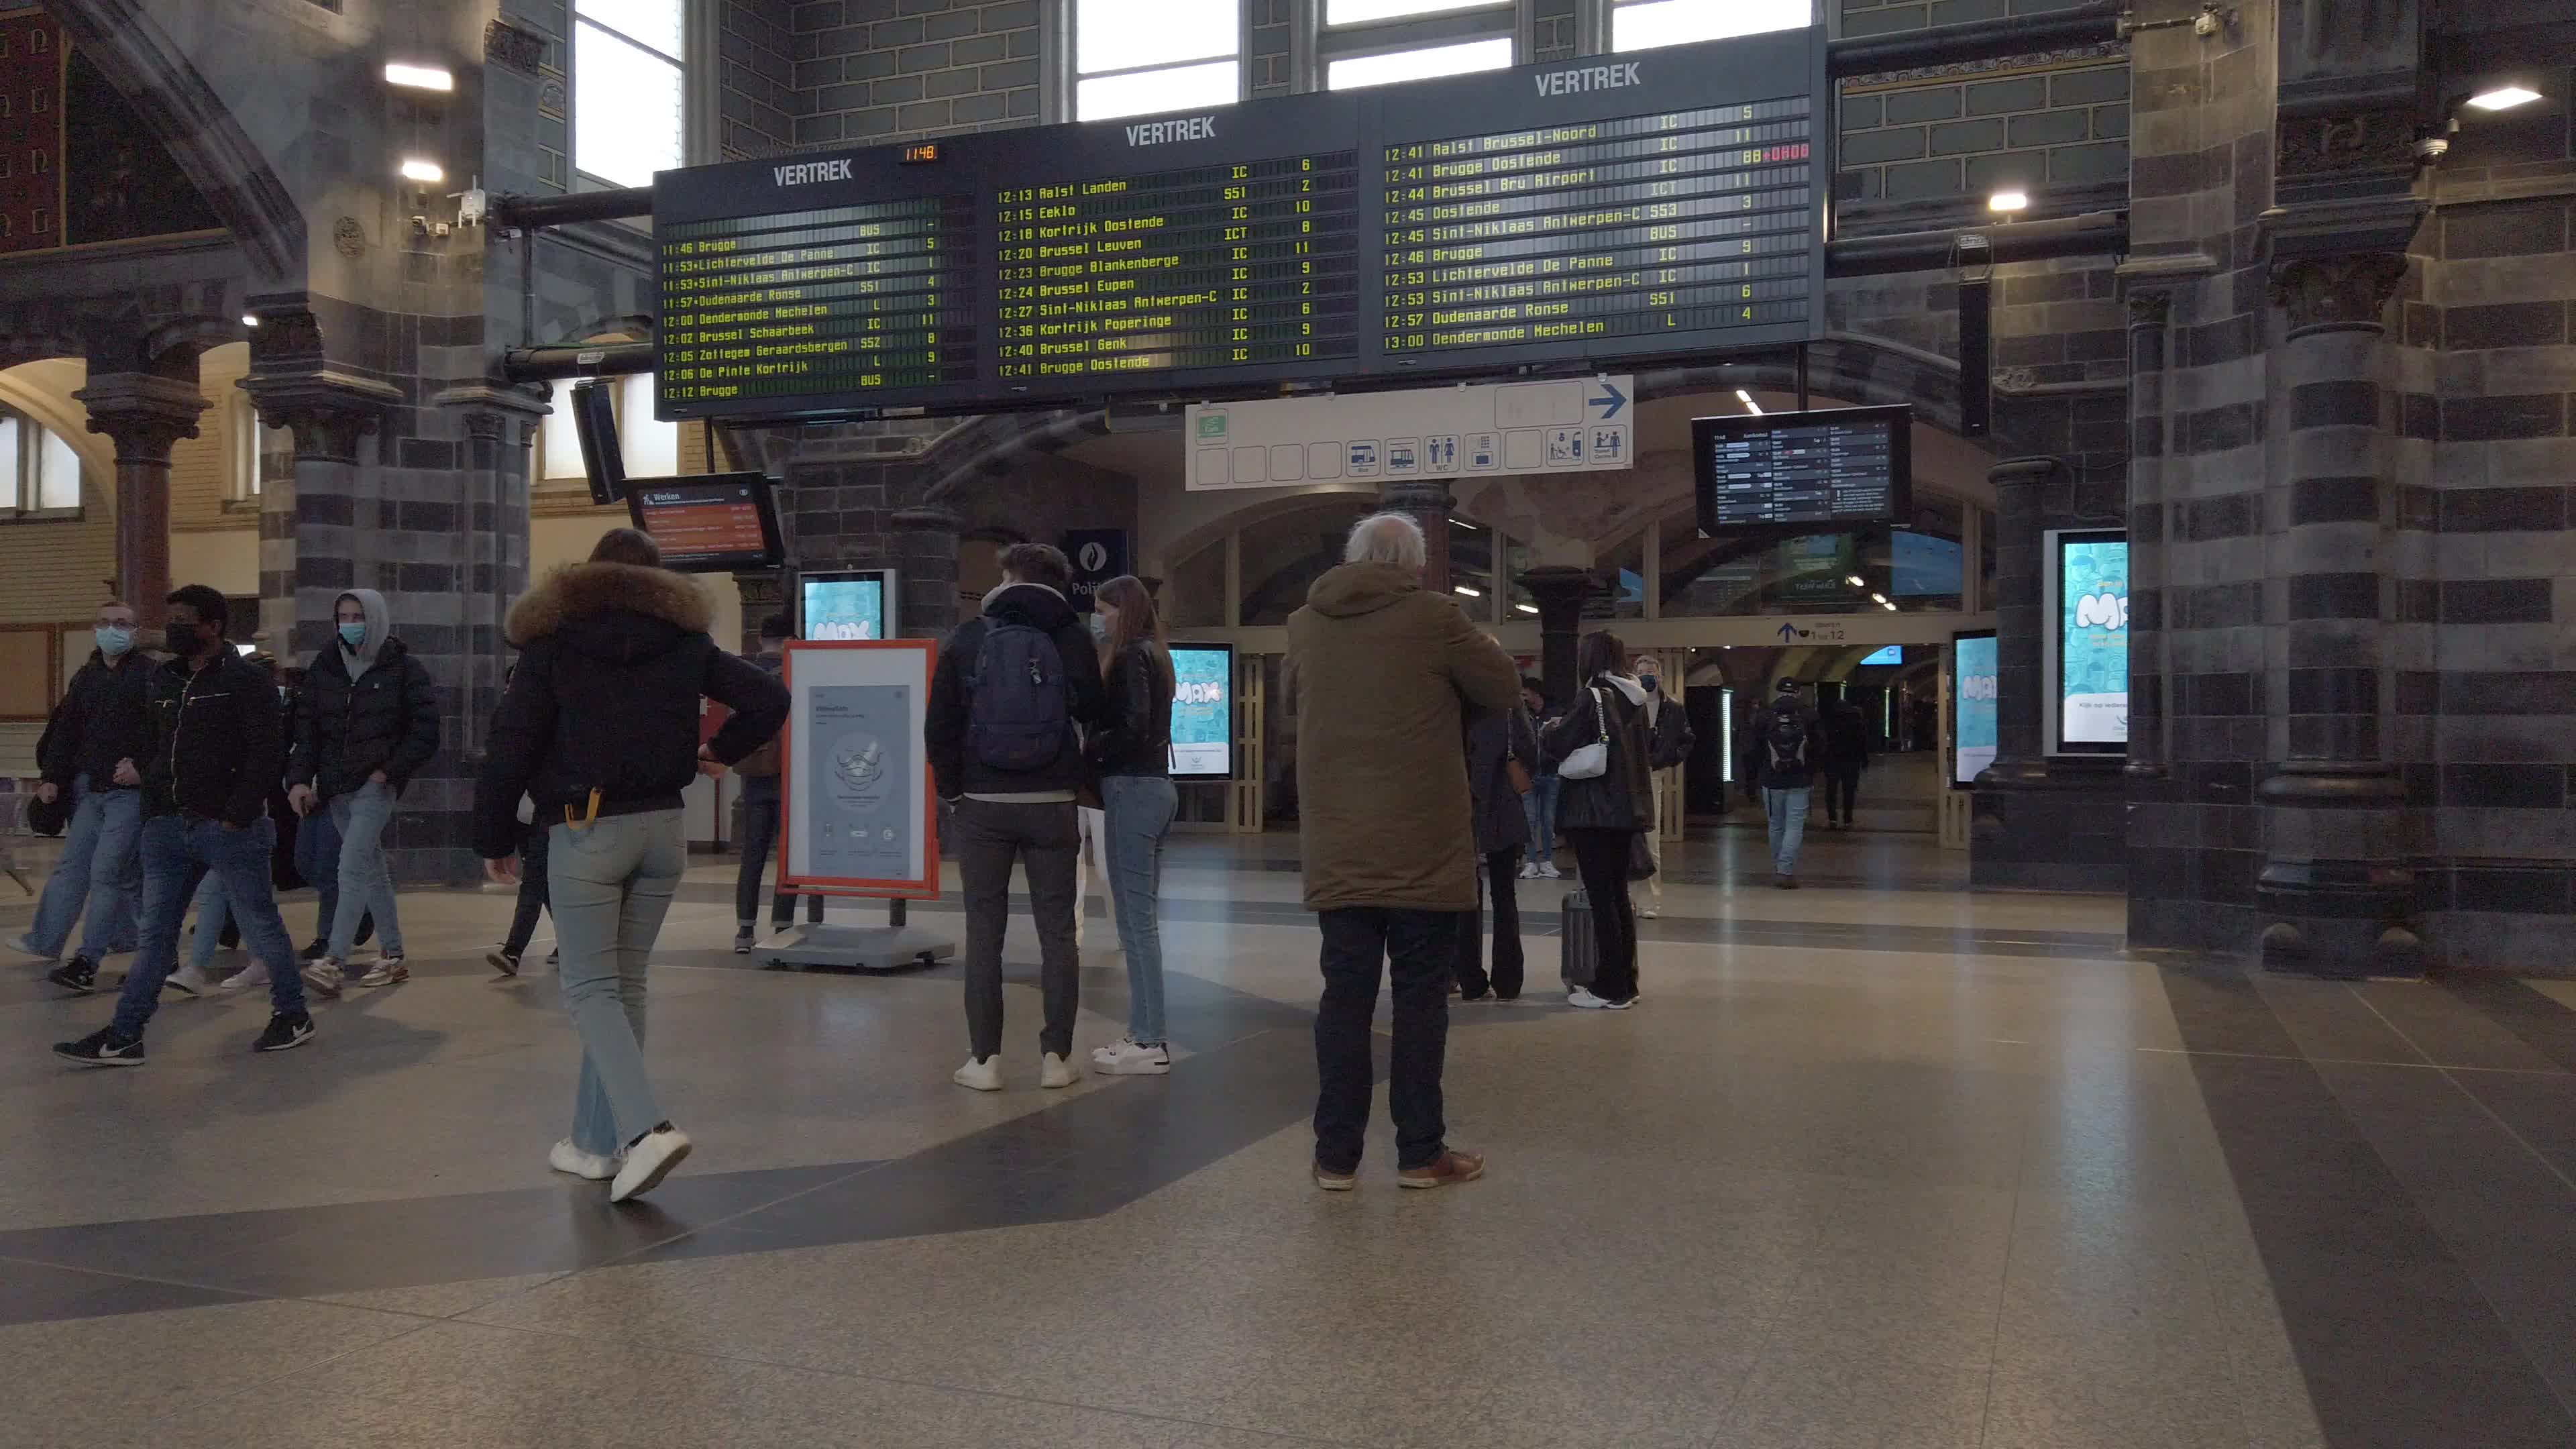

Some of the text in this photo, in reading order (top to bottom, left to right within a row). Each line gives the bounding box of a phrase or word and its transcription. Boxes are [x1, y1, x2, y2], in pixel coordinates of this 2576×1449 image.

[1535, 62, 1641, 97] VERTREK
[1126, 115, 1216, 146] VERTREK
[1385, 105, 1753, 162] 12:41 Aalst Brussel-Noord IC 5
[773, 158, 852, 186] VERTREK
[1385, 128, 1750, 183] 12:41 Brugge Oostende IC 11
[999, 158, 1309, 204] 12:13 Aalst Landen IC 6
[1385, 187, 1424, 204] 12:44
[1433, 180, 1489, 199] Brussel
[1501, 178, 1526, 191] Bru
[1535, 168, 1595, 187] Airport
[1660, 158, 1678, 173] IC
[1385, 172, 1750, 225] 12:45 Oostende ICT 11
[999, 209, 1032, 223] 12:15
[1039, 205, 1075, 219] Eeklo
[1302, 178, 1310, 191] 2
[999, 199, 1310, 242] 12:18 Kortrijk Oostende IC 10
[1385, 229, 1424, 246] 12:45
[1433, 221, 1534, 240] Sint-Niklaas
[1544, 207, 1641, 229] Antwerpen-C
[1743, 195, 1752, 209] 3
[663, 223, 879, 256] 11:46 Brugge BUS
[782, 251, 794, 262] De
[800, 249, 833, 260] Panne
[867, 242, 879, 254] IC
[927, 237, 934, 249] 5
[999, 220, 1310, 262] 12:20 Brussel Leuven ICT 8
[1385, 225, 1677, 266] 12:46 Brugge BUS
[782, 264, 853, 280] Antwerpen-C
[867, 261, 879, 273] IC
[928, 256, 932, 268] 1
[999, 241, 1307, 281] 12:23 Brugge Blankenberge IC 11
[1385, 239, 1752, 287] 12:53 Lichtervelde De Panne IC 9
[769, 289, 801, 301] Ronse
[927, 275, 934, 286] 4
[999, 261, 1310, 300] 12:24 Brussel Eupen IC 9
[1385, 262, 1749, 308] 12:53 Sint-Niklaas Antwerpen-C IC 1
[663, 294, 934, 327] 12:00 Dendermonde Mechelen L 3
[999, 282, 1310, 319] 12:27 Sint-Niklaas Antwerpen-C IC 2
[1385, 313, 1424, 328] 12:57
[1432, 306, 1517, 324] Oudenaarde
[1525, 303, 1569, 316] Ronse
[1742, 284, 1751, 298] 6
[663, 313, 932, 345] 12:02 Brussel Schaarbeek IC 11
[1000, 302, 1310, 339] 12:36 Kortrijk Poperinge IC 6
[1385, 307, 1751, 349] 13:00 Dendermonde Mechelen L 4
[664, 350, 694, 363] 12:05
[700, 348, 750, 360] Zottegem
[756, 341, 847, 356] Geraardsbergen
[928, 332, 934, 343] 8
[1000, 323, 1310, 358] 12:40 Brussel Genk IC 9
[664, 351, 934, 381] 12:06 De Pinte Kortrijk L 9
[1000, 343, 1310, 377] 12:41 Brugge Oostende IC 10
[664, 374, 881, 399] 12:12 Brugge BUS
[653, 493, 680, 501] Werken
[1830, 631, 1845, 640] 12
